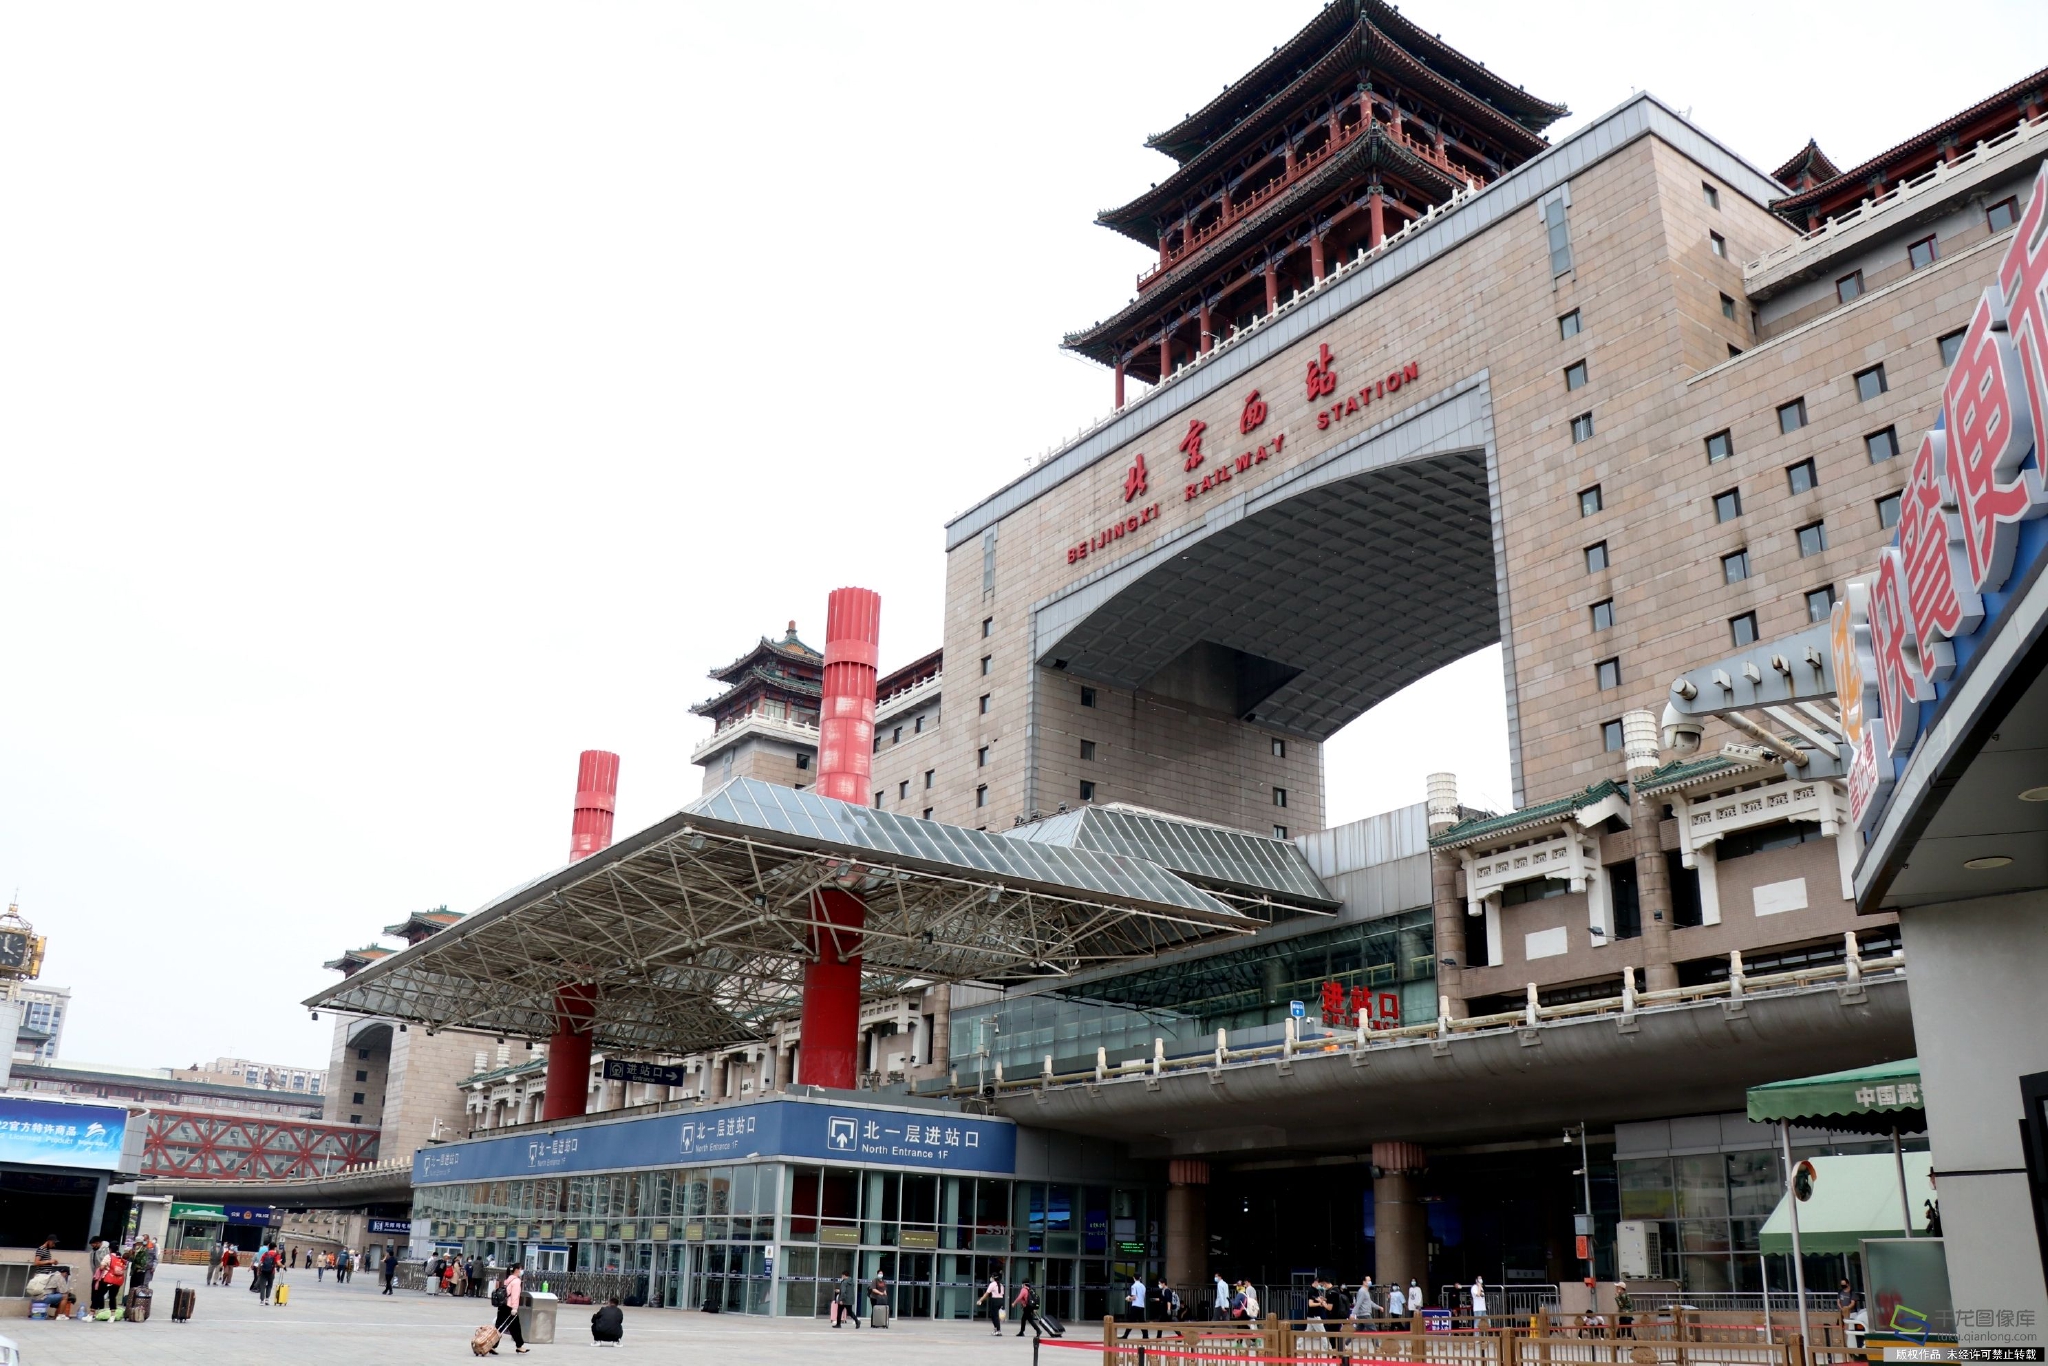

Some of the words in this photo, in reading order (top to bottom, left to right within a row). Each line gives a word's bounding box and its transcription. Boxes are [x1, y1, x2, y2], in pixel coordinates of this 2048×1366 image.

[1124, 342, 1337, 502] 北京西站
[1066, 502, 1161, 565] BEIJINGXI
[1184, 432, 1286, 502] RAILWAY
[1317, 360, 1420, 431] STATION
[1321, 981, 1399, 1020] 进站口
[1322, 1013, 1399, 1031] ENTRNCE
[626, 1063, 663, 1078] 进站口
[632, 1075, 656, 1083] Entrance
[1855, 1083, 1924, 1107] 中国武
[697, 1116, 756, 1140] 北一层进站口
[863, 1120, 979, 1148] 北一层进站口
[46, 1136, 73, 1145] Product
[539, 1138, 578, 1156] 北一层进站口
[695, 1144, 708, 1153] North
[710, 1142, 730, 1152] Entrance
[732, 1140, 739, 1149] 1F
[862, 1143, 888, 1154] North
[892, 1147, 933, 1159] Entrance
[938, 1150, 948, 1159] 1F
